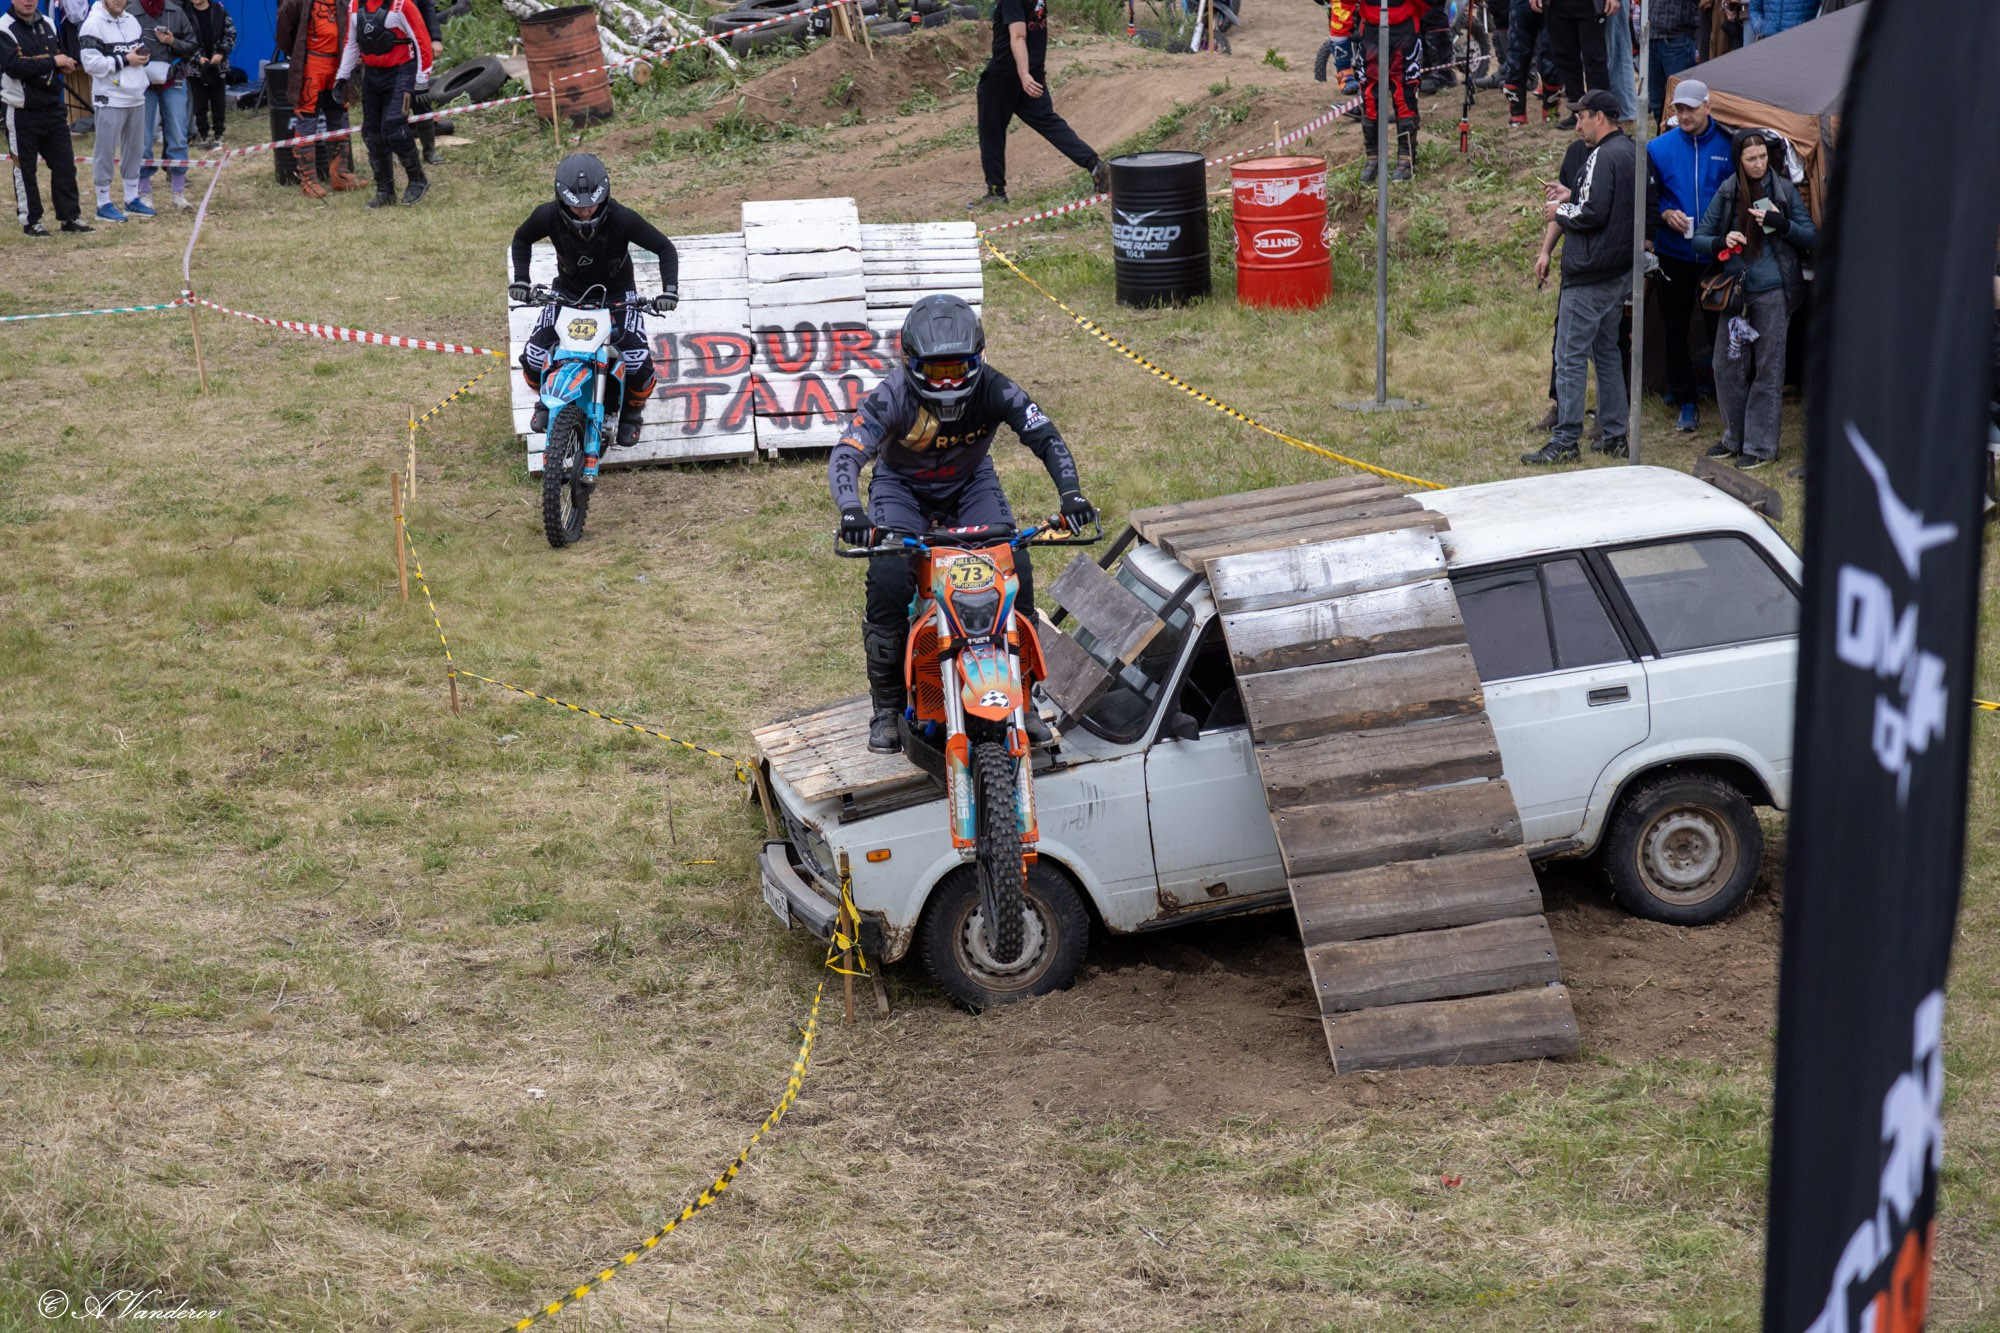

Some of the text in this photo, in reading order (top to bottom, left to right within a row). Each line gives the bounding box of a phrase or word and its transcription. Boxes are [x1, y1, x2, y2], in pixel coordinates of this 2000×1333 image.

[562, 189, 580, 205] AIROH
[1112, 223, 1181, 242] ECORD
[1133, 241, 1170, 251] RADIO
[1254, 236, 1300, 249] SINTEC
[1125, 250, 1146, 259] 104.4
[574, 325, 589, 335] 44
[960, 566, 983, 582] 73
